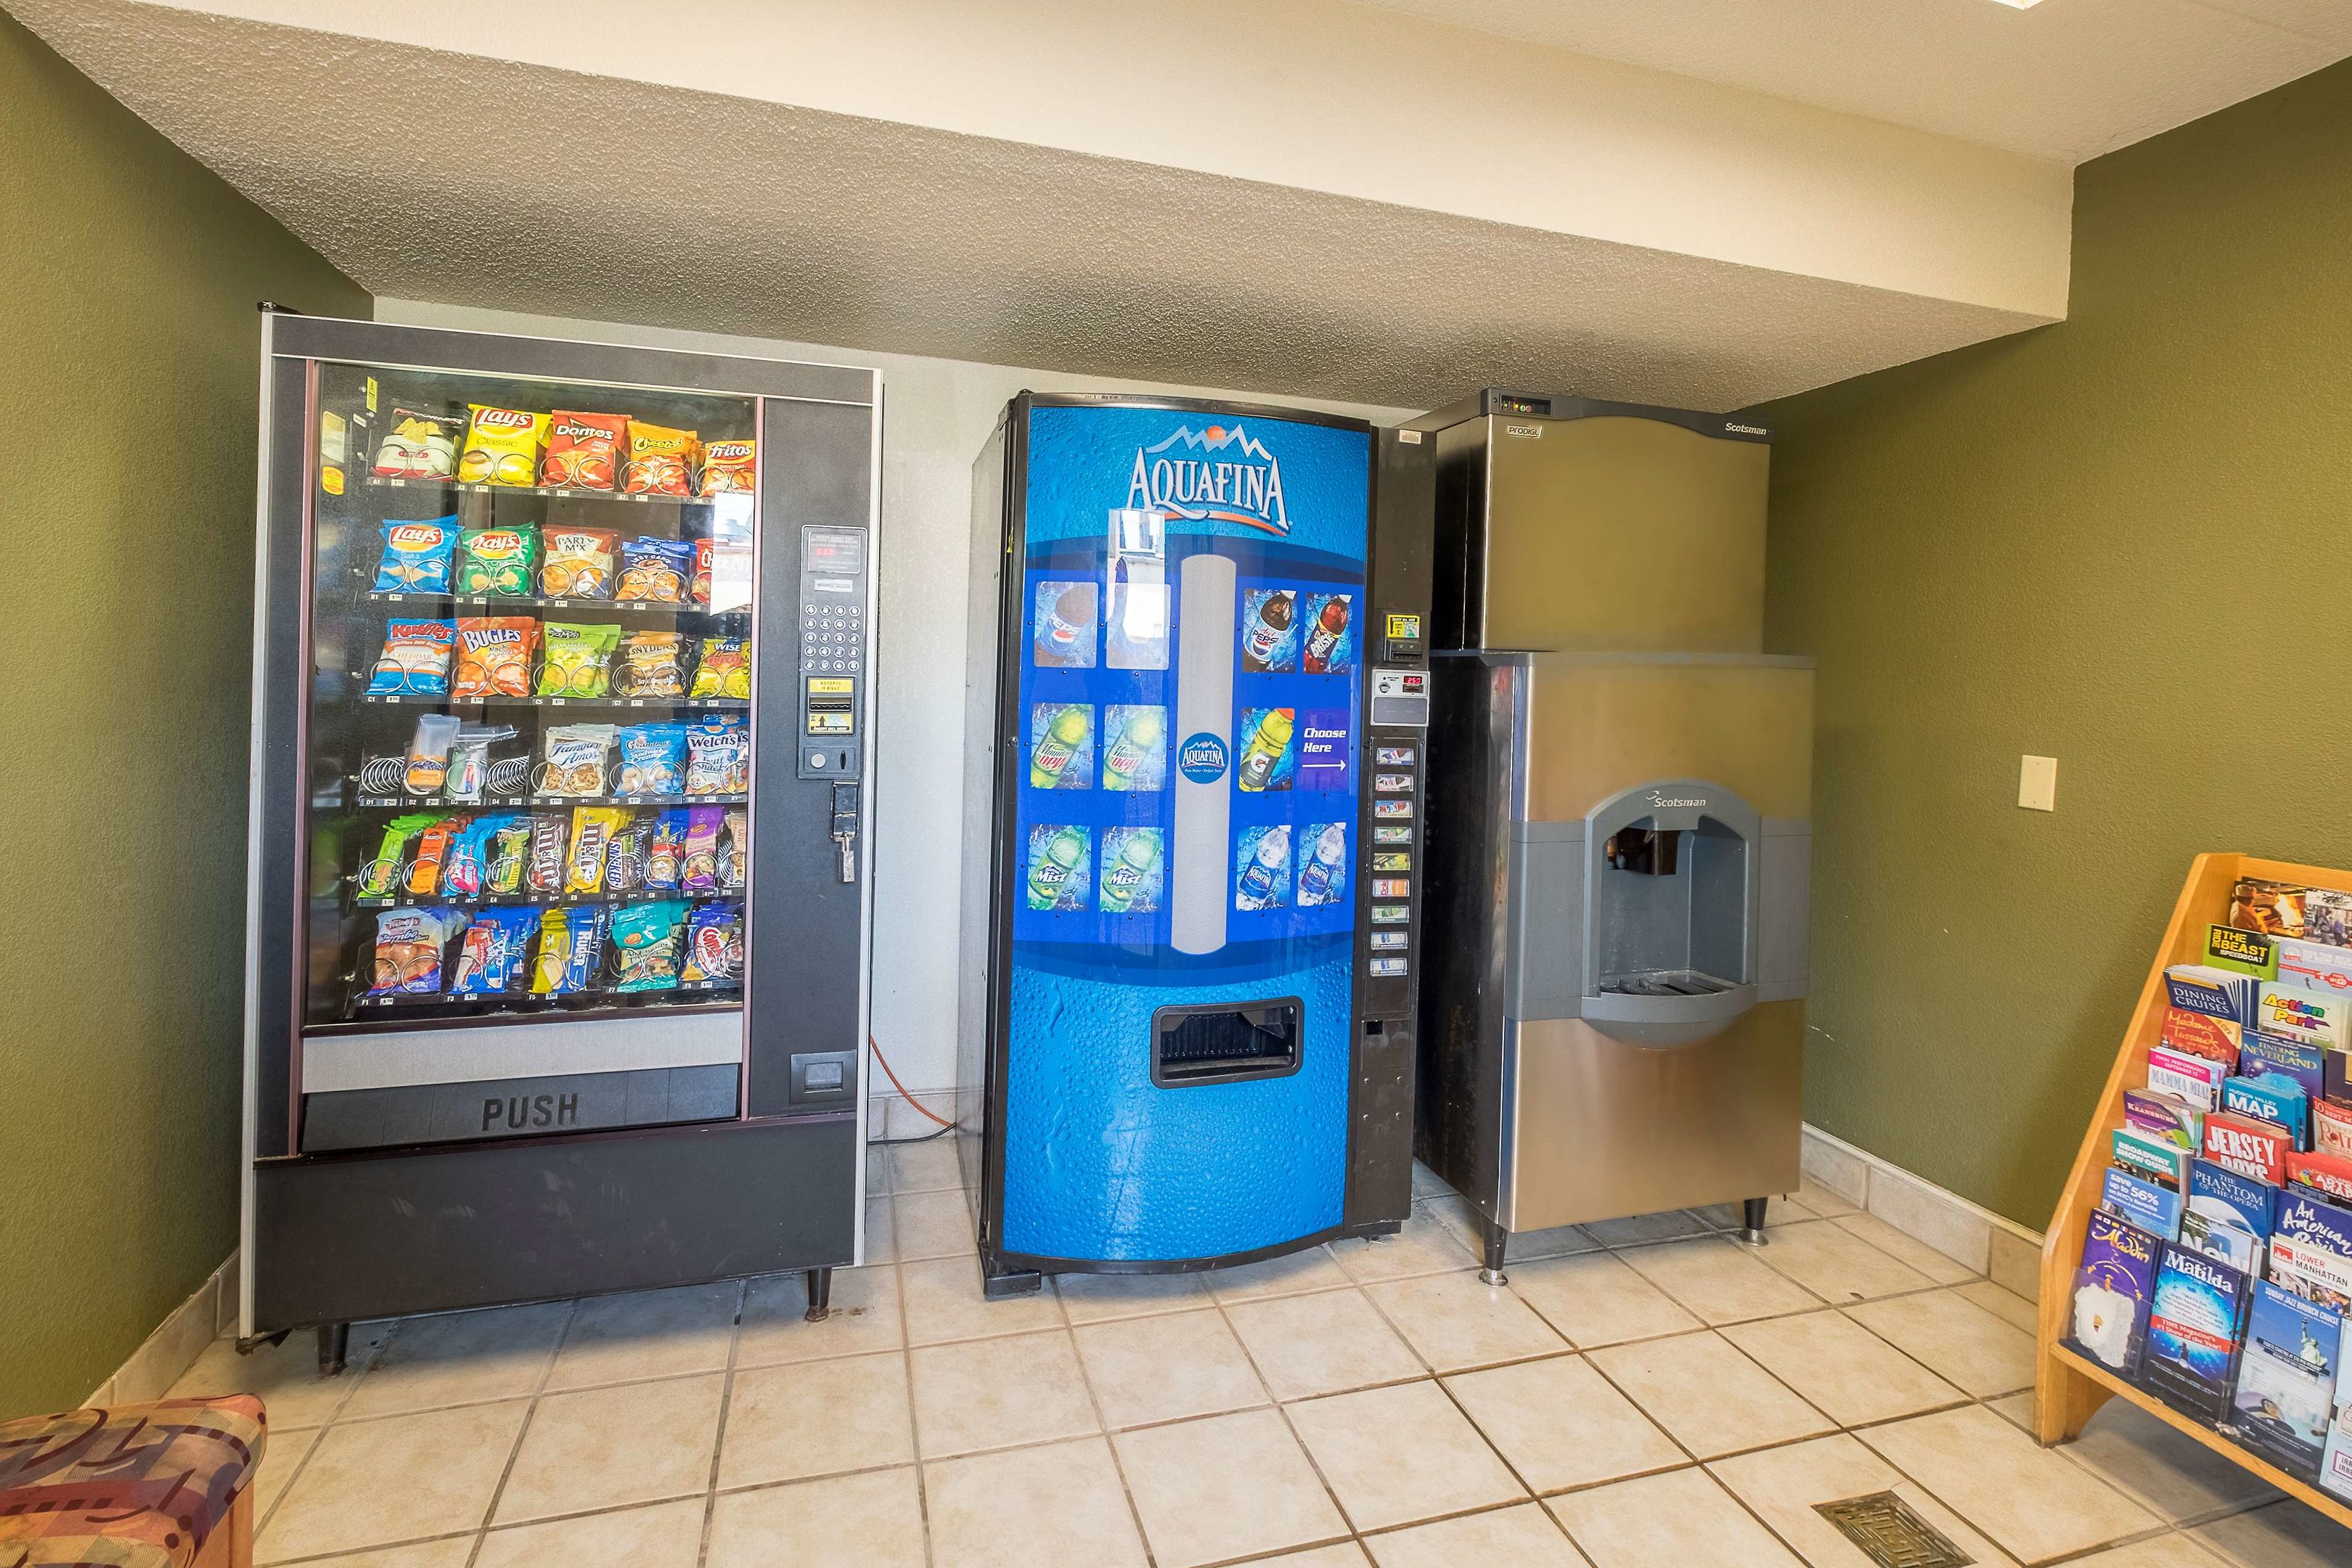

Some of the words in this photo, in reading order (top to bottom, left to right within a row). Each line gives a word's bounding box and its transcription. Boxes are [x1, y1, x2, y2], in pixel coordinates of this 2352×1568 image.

[556, 425, 615, 441] Doritos
[1724, 422, 1767, 436] Scotsman
[476, 437, 519, 448] Classic
[634, 437, 683, 453] Cheetos
[1126, 446, 1291, 534] AQUAFINA
[461, 629, 521, 653] BUGLES
[1251, 628, 1280, 645] PEPSI
[1310, 633, 1336, 658] BRISK
[714, 643, 741, 653] WISE
[1303, 727, 1347, 739] Choose
[549, 742, 600, 757] Famous
[690, 736, 738, 749] Welch's
[1303, 742, 1333, 754] Here
[1181, 746, 1225, 767] AQUAFINA
[1249, 752, 1271, 775] G
[1654, 797, 1707, 809] Scotsman
[1034, 870, 1069, 884] Mist
[1108, 872, 1142, 886] Mist
[2212, 928, 2221, 949] RIDE
[2223, 930, 2247, 942] THE
[2219, 939, 2268, 957] BEAST
[2219, 948, 2265, 964] SPEEDBOAT
[2173, 987, 2226, 1005] DINING
[2175, 996, 2230, 1015] CRUISES
[2263, 993, 2325, 1018] Action
[2168, 1010, 2217, 1034] Madame
[2273, 1008, 2331, 1031] Park
[2168, 1024, 2220, 1053] Tussauds
[2220, 1024, 2233, 1036] OFF
[2243, 1042, 2318, 1070] NEVERLAND
[2258, 1042, 2300, 1058] FINDING
[2150, 1068, 2188, 1093] MAMMA
[2227, 1092, 2279, 1119] MAP
[2254, 1095, 2277, 1107] VALLEY
[481, 1093, 581, 1132] PUSH
[2207, 1125, 2275, 1167] JERSEY
[2115, 1147, 2144, 1164] SHOW
[2110, 1173, 2132, 1187] save
[2195, 1169, 2264, 1206] PHANTOM
[2218, 1173, 2237, 1185] THE
[2109, 1180, 2120, 1191] up
[2120, 1185, 2129, 1194] to
[2130, 1186, 2160, 1206] 56%
[2199, 1181, 2210, 1191] OF
[2211, 1186, 2230, 1199] THE
[2230, 1194, 2259, 1211] OPERA
[2295, 1200, 2315, 1221] An
[2282, 1208, 2352, 1255] American
[2091, 1228, 2150, 1264] Aladdin
[2295, 1251, 2326, 1269] LOWER
[2164, 1249, 2234, 1294] Matilda
[2295, 1260, 2349, 1286] MANHATTAN
